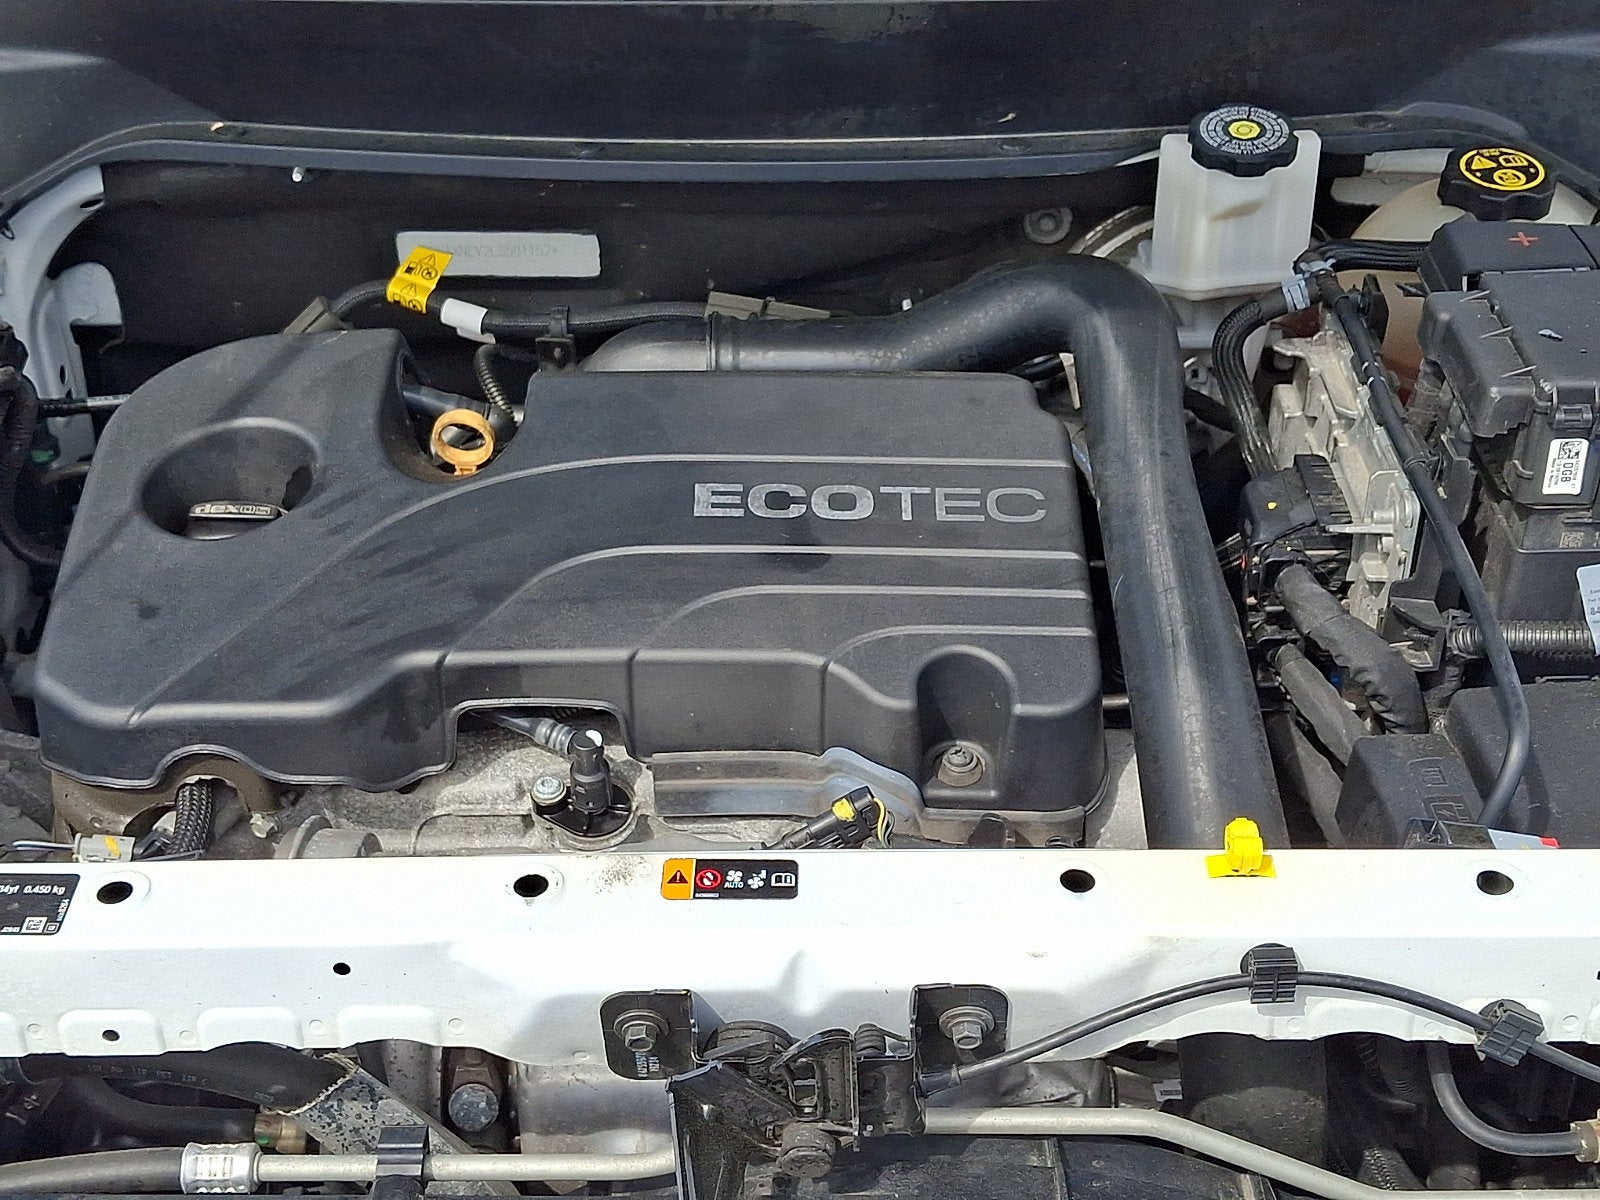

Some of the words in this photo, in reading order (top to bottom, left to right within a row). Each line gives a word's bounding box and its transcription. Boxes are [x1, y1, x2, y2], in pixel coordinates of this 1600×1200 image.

[693, 482, 1047, 523] ECOTEC
[194, 503, 271, 516] dexos
[23, 885, 52, 895] 0.450
[51, 885, 66, 896] kg
[723, 881, 745, 889] AUTO
